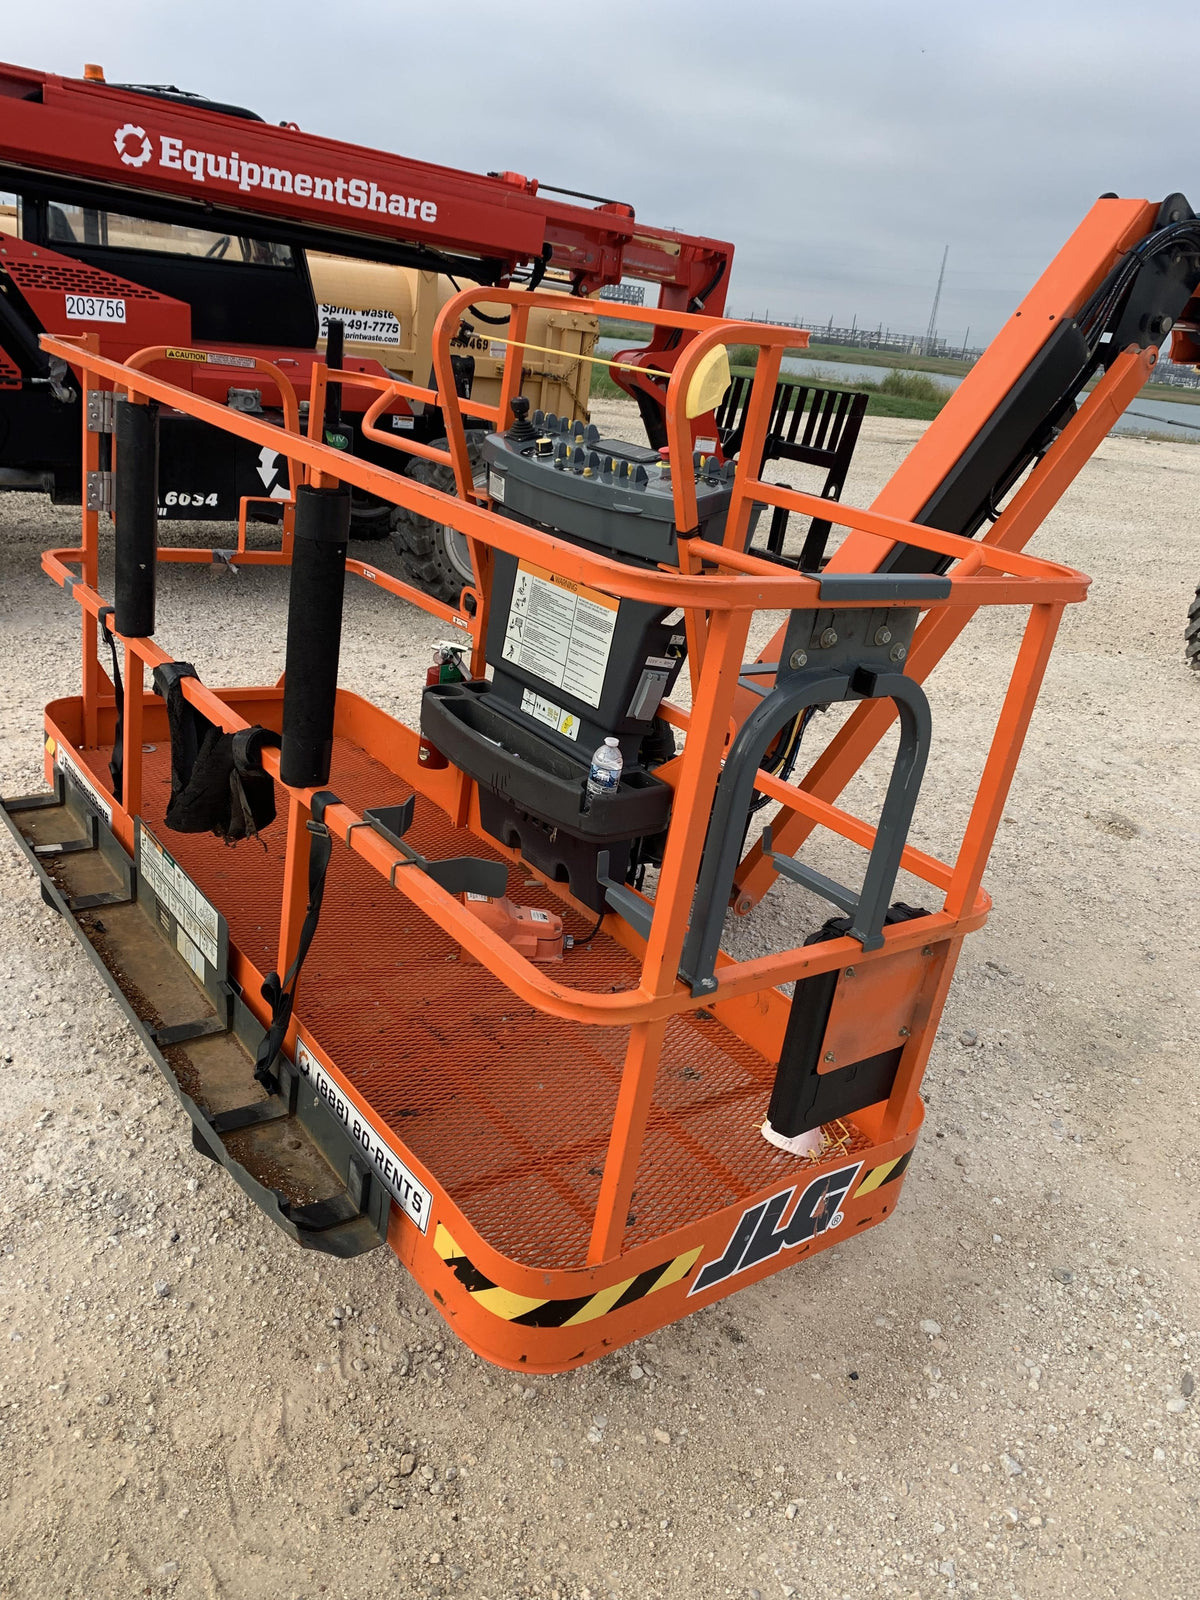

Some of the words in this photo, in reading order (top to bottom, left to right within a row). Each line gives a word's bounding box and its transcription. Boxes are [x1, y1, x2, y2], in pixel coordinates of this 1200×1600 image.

[159, 135, 437, 222] EquipmentShare
[66, 296, 124, 318] 203756
[321, 304, 356, 315] Sprint
[321, 317, 399, 333] 2-491-7775
[175, 352, 205, 360] CAUTION
[165, 491, 218, 506] 6034
[555, 576, 578, 592] WARNING
[316, 1072, 349, 1127] (888)
[353, 1119, 423, 1214] 80-RENTS
[687, 1160, 865, 1298] JLG
